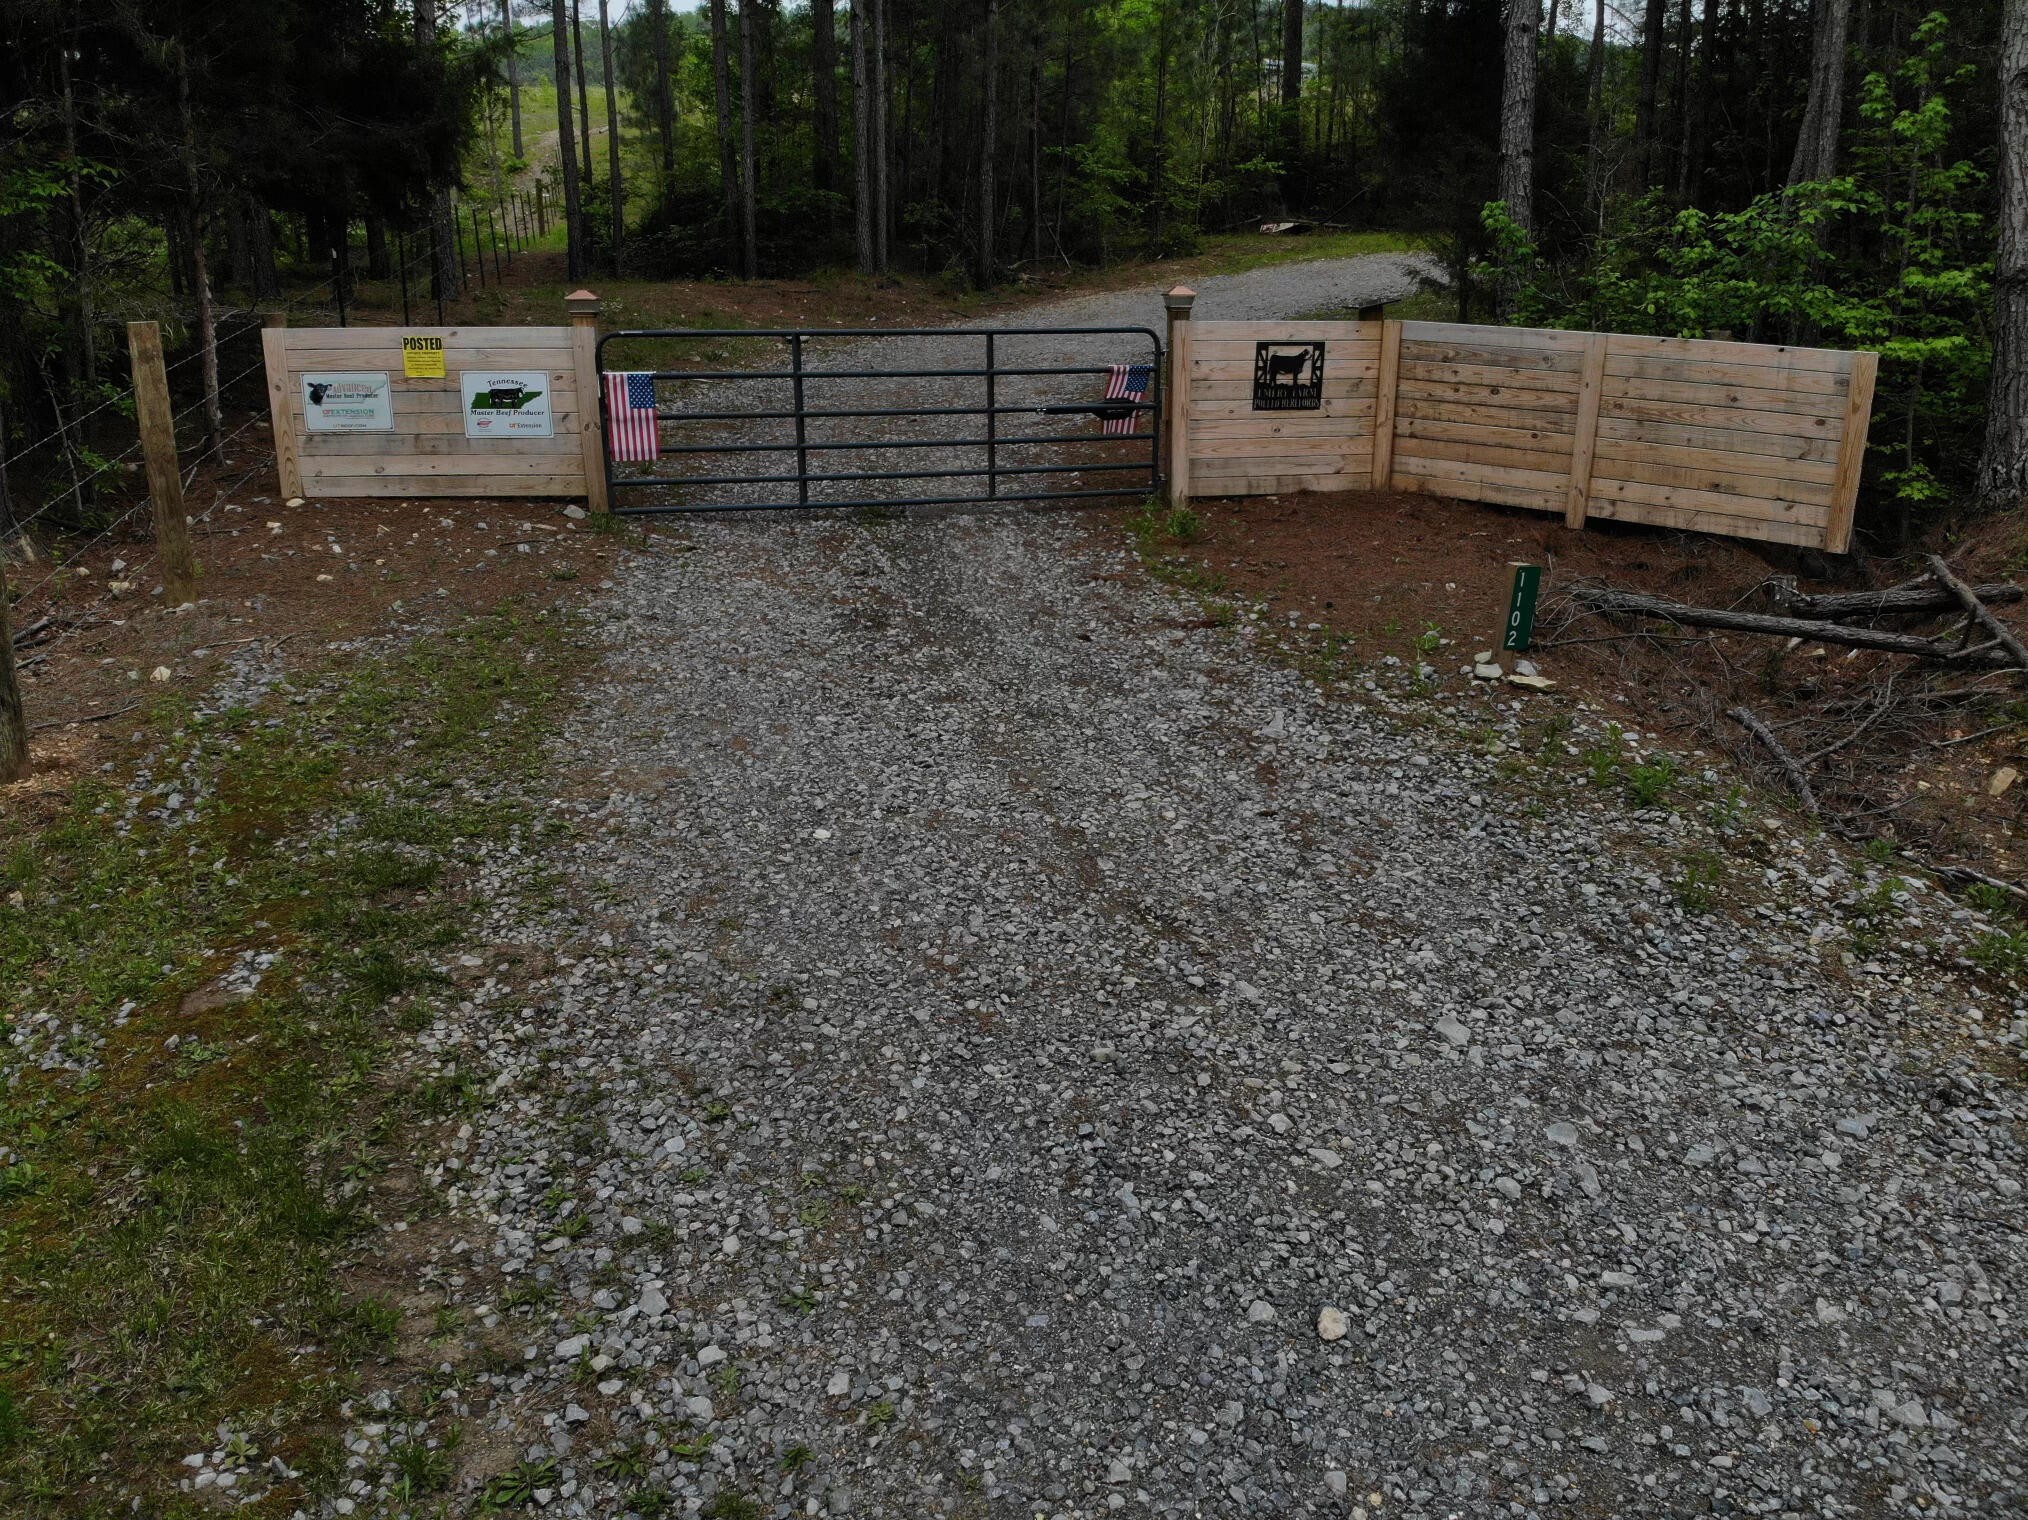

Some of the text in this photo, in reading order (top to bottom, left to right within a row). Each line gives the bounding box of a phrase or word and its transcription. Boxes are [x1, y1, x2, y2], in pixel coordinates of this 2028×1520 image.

[403, 337, 442, 350] POSTED
[487, 379, 529, 389] Tennessee
[496, 409, 512, 417] Beef
[1507, 571, 1525, 646] 1102
